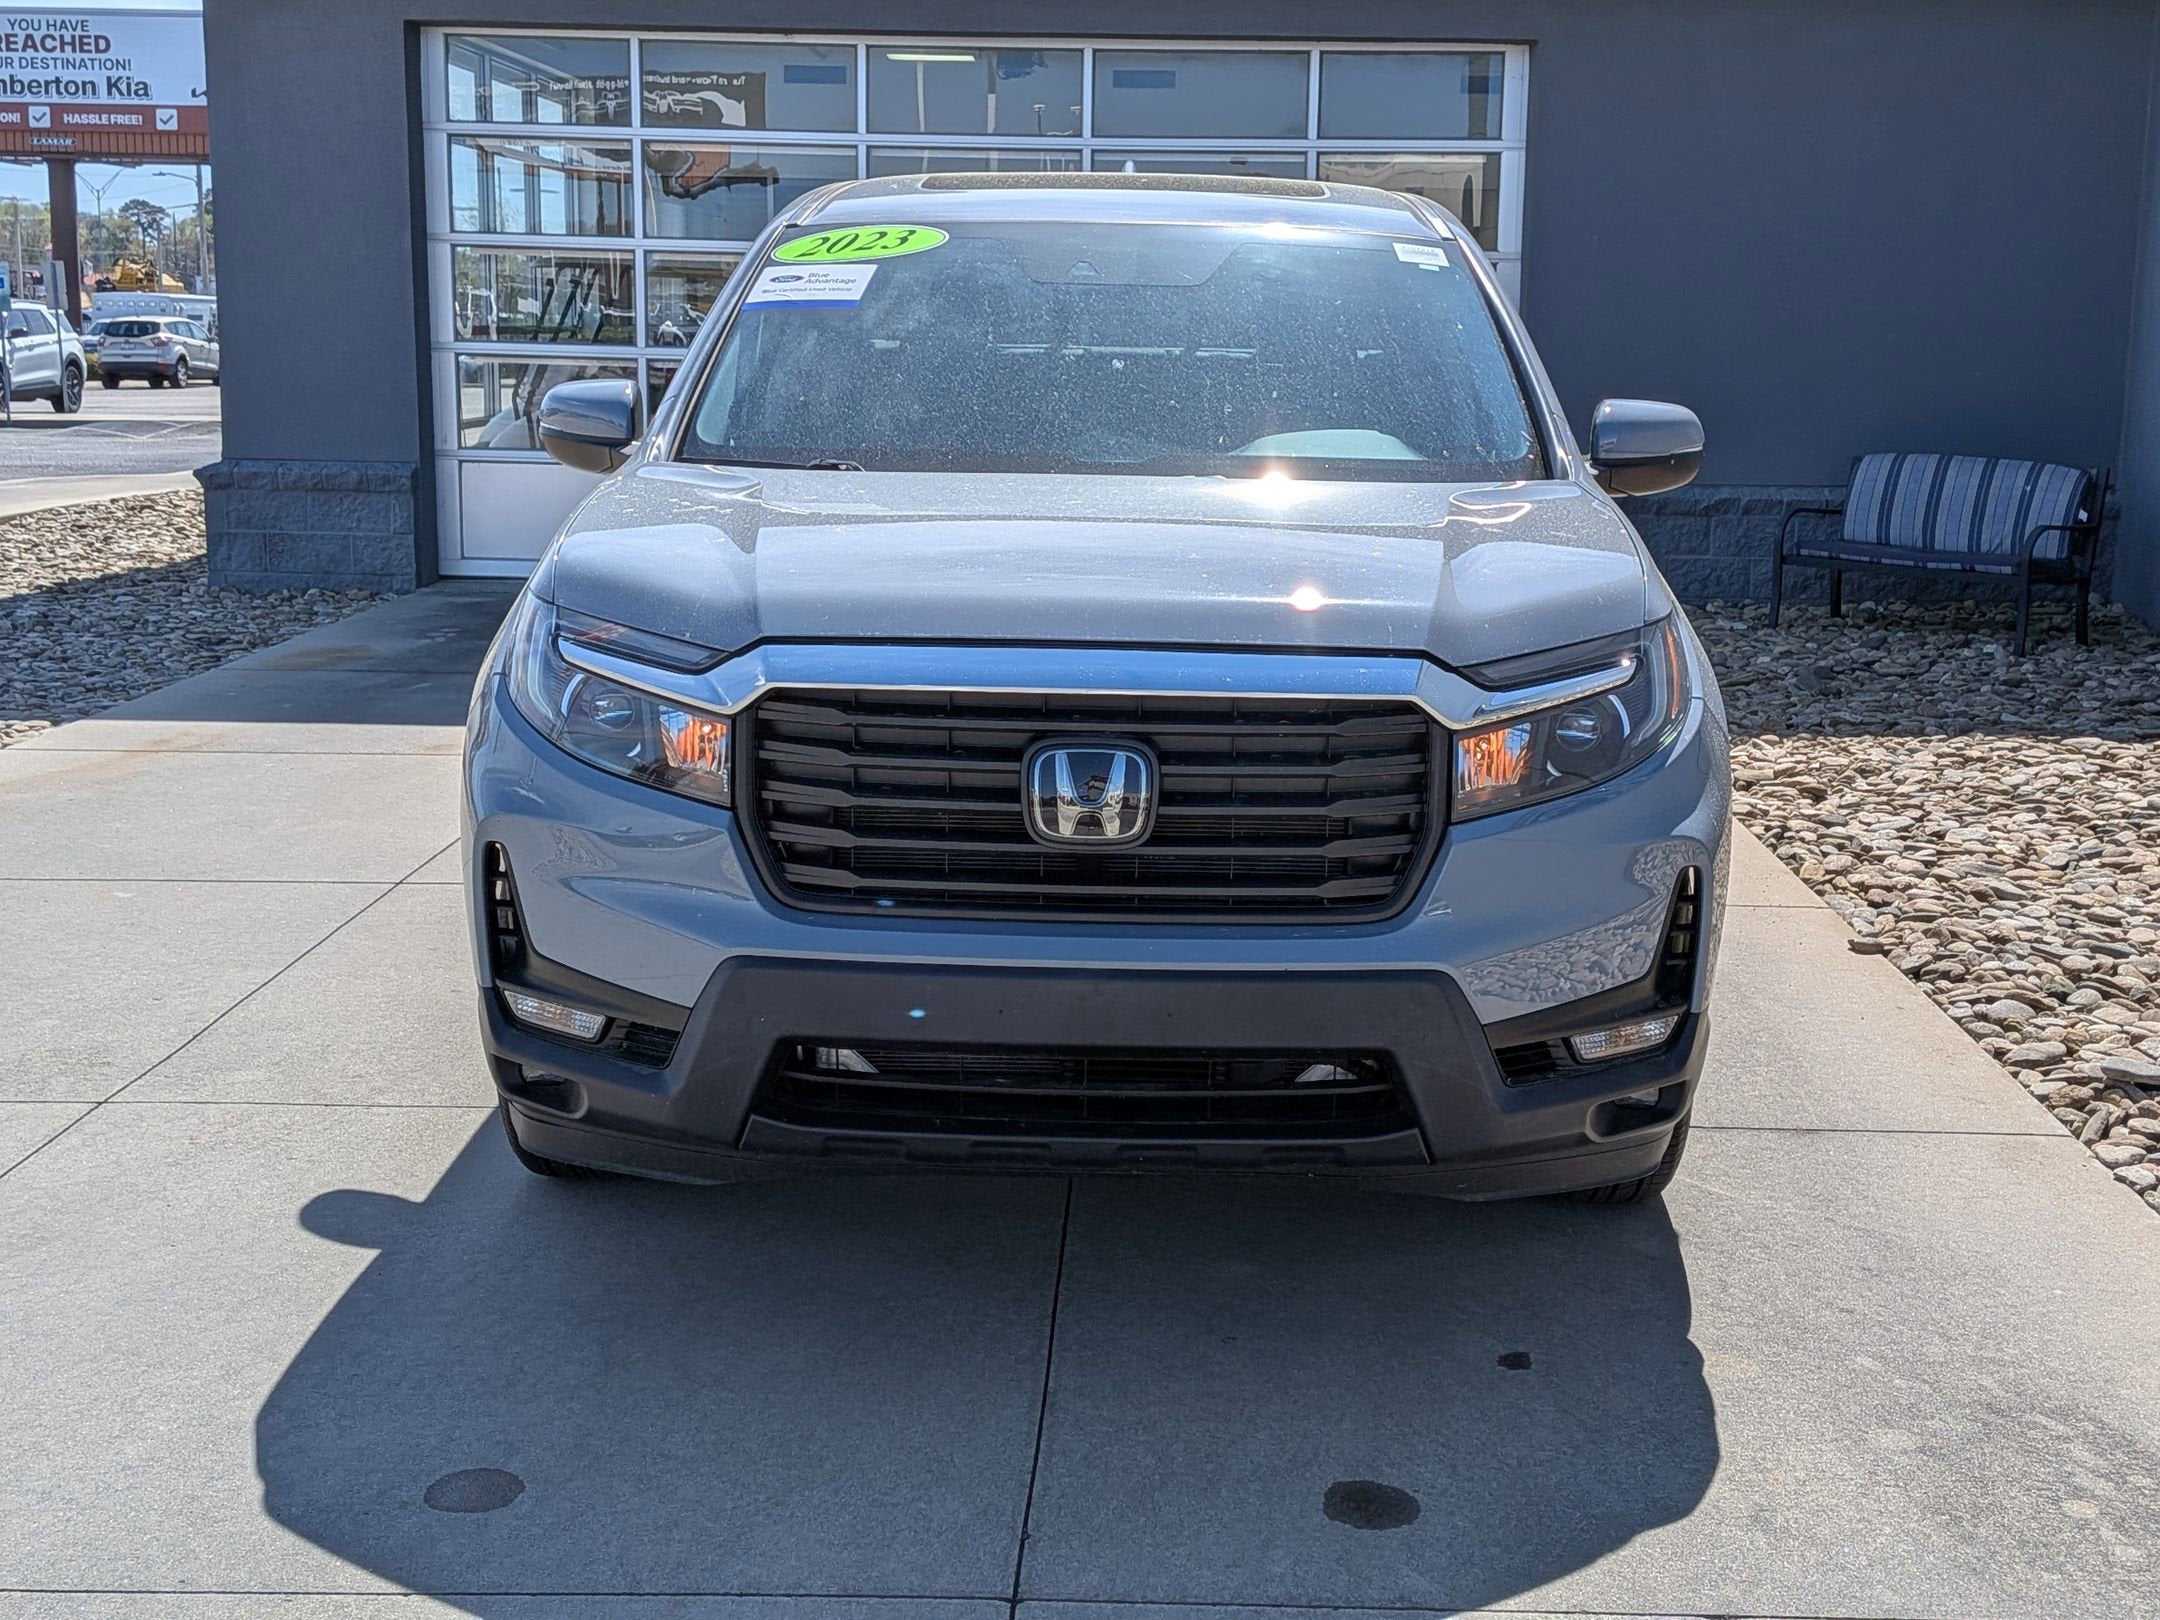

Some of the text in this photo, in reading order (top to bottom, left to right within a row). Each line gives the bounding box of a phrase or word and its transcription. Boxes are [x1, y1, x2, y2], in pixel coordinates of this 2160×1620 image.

[7, 18, 90, 32] YOU HAVE
[0, 33, 111, 54] EACHED
[18, 57, 132, 71] DESTINATION!
[106, 76, 152, 99] Kia
[63, 113, 110, 125] HASSLE
[110, 114, 143, 126] FREE!
[793, 229, 917, 259] 2023
[804, 278, 857, 286] Advantage
